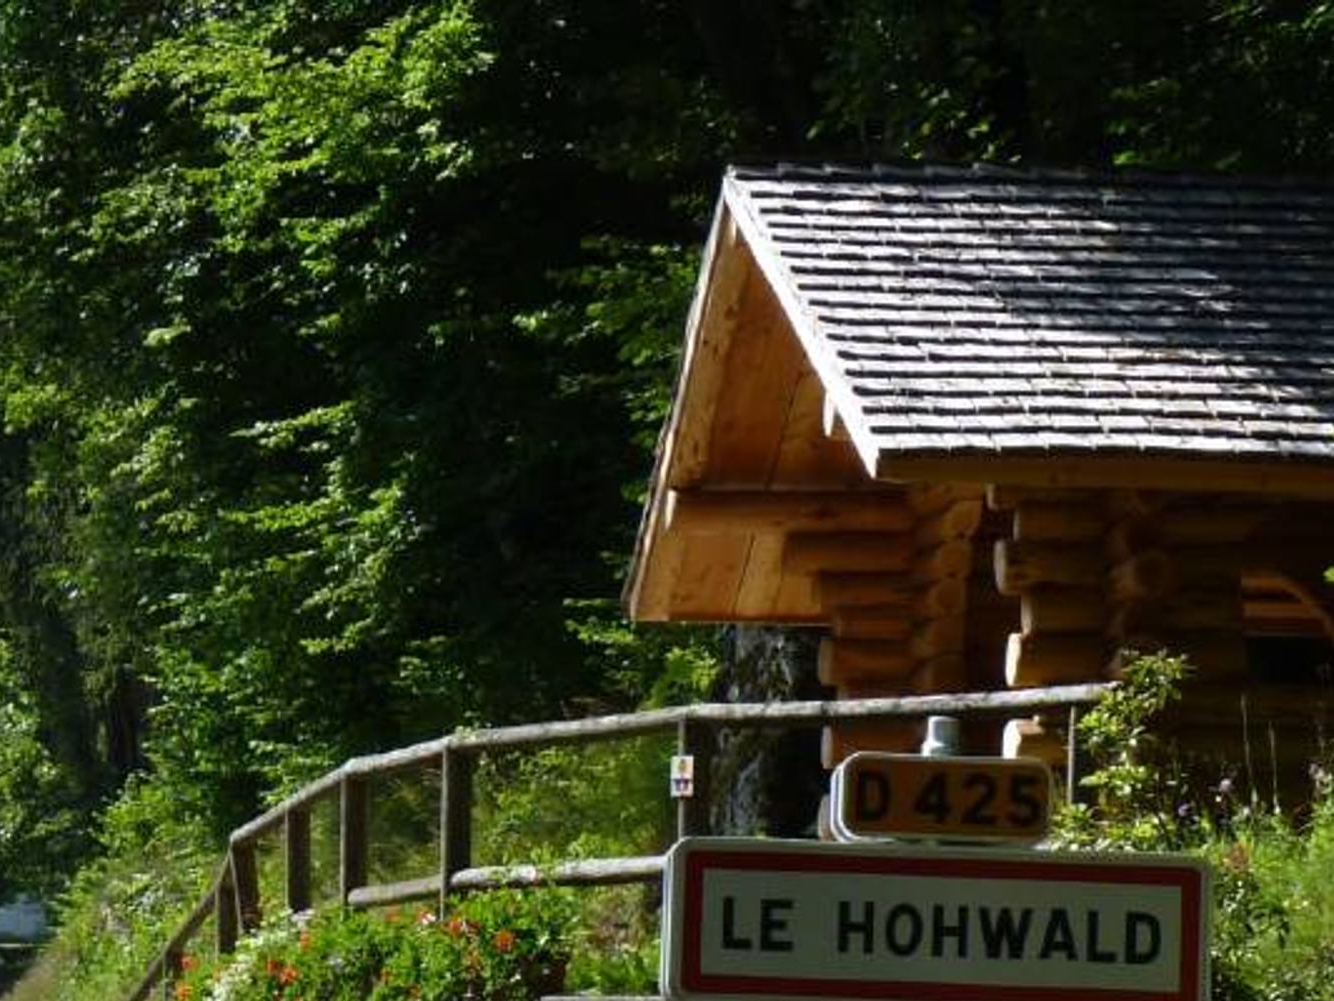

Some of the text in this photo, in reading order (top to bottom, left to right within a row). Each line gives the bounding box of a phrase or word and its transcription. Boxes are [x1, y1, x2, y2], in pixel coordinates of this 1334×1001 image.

[856, 770, 1044, 829] D 425
[721, 897, 1163, 966] LE HOHWALD
